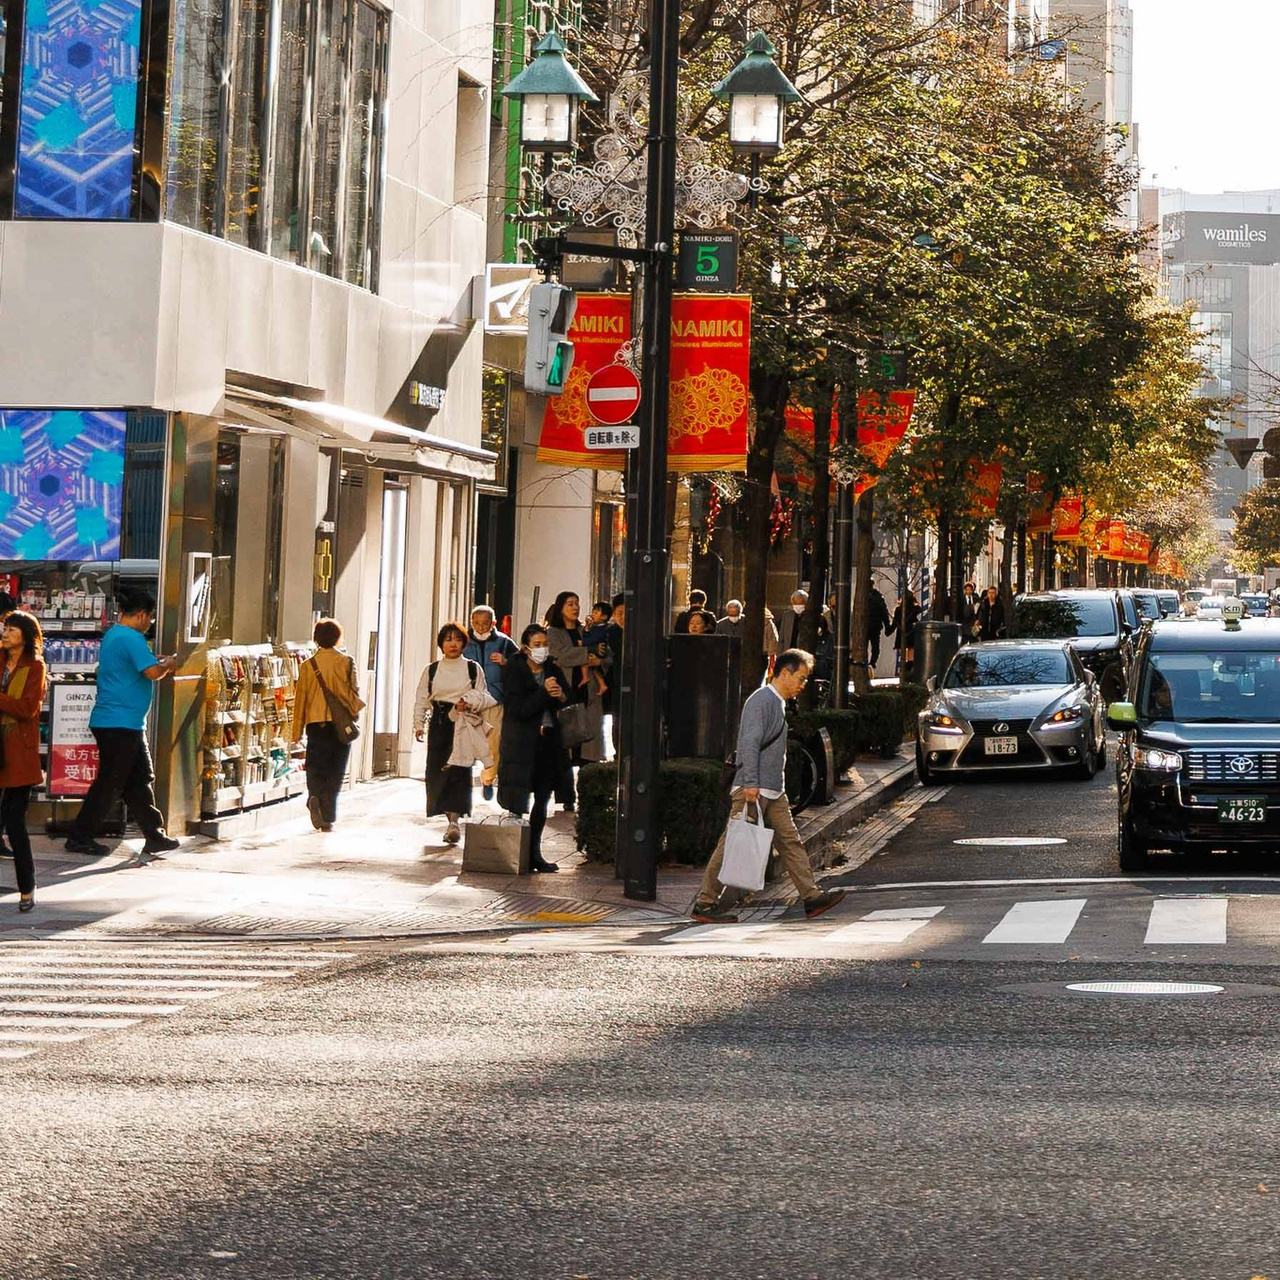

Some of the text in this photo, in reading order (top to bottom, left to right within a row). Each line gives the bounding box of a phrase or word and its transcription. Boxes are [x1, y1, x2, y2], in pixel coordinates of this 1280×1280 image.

[684, 235, 733, 243] NAMIKI-DORI
[1202, 223, 1267, 242] wamiles
[695, 246, 720, 276] 5
[695, 275, 720, 283] GINZA
[570, 315, 624, 334] AMIKI
[670, 319, 743, 337] NAMIKI
[588, 431, 636, 445] 自転車を除く
[992, 743, 1017, 753] 18-73
[1228, 808, 1264, 821] 46-23
